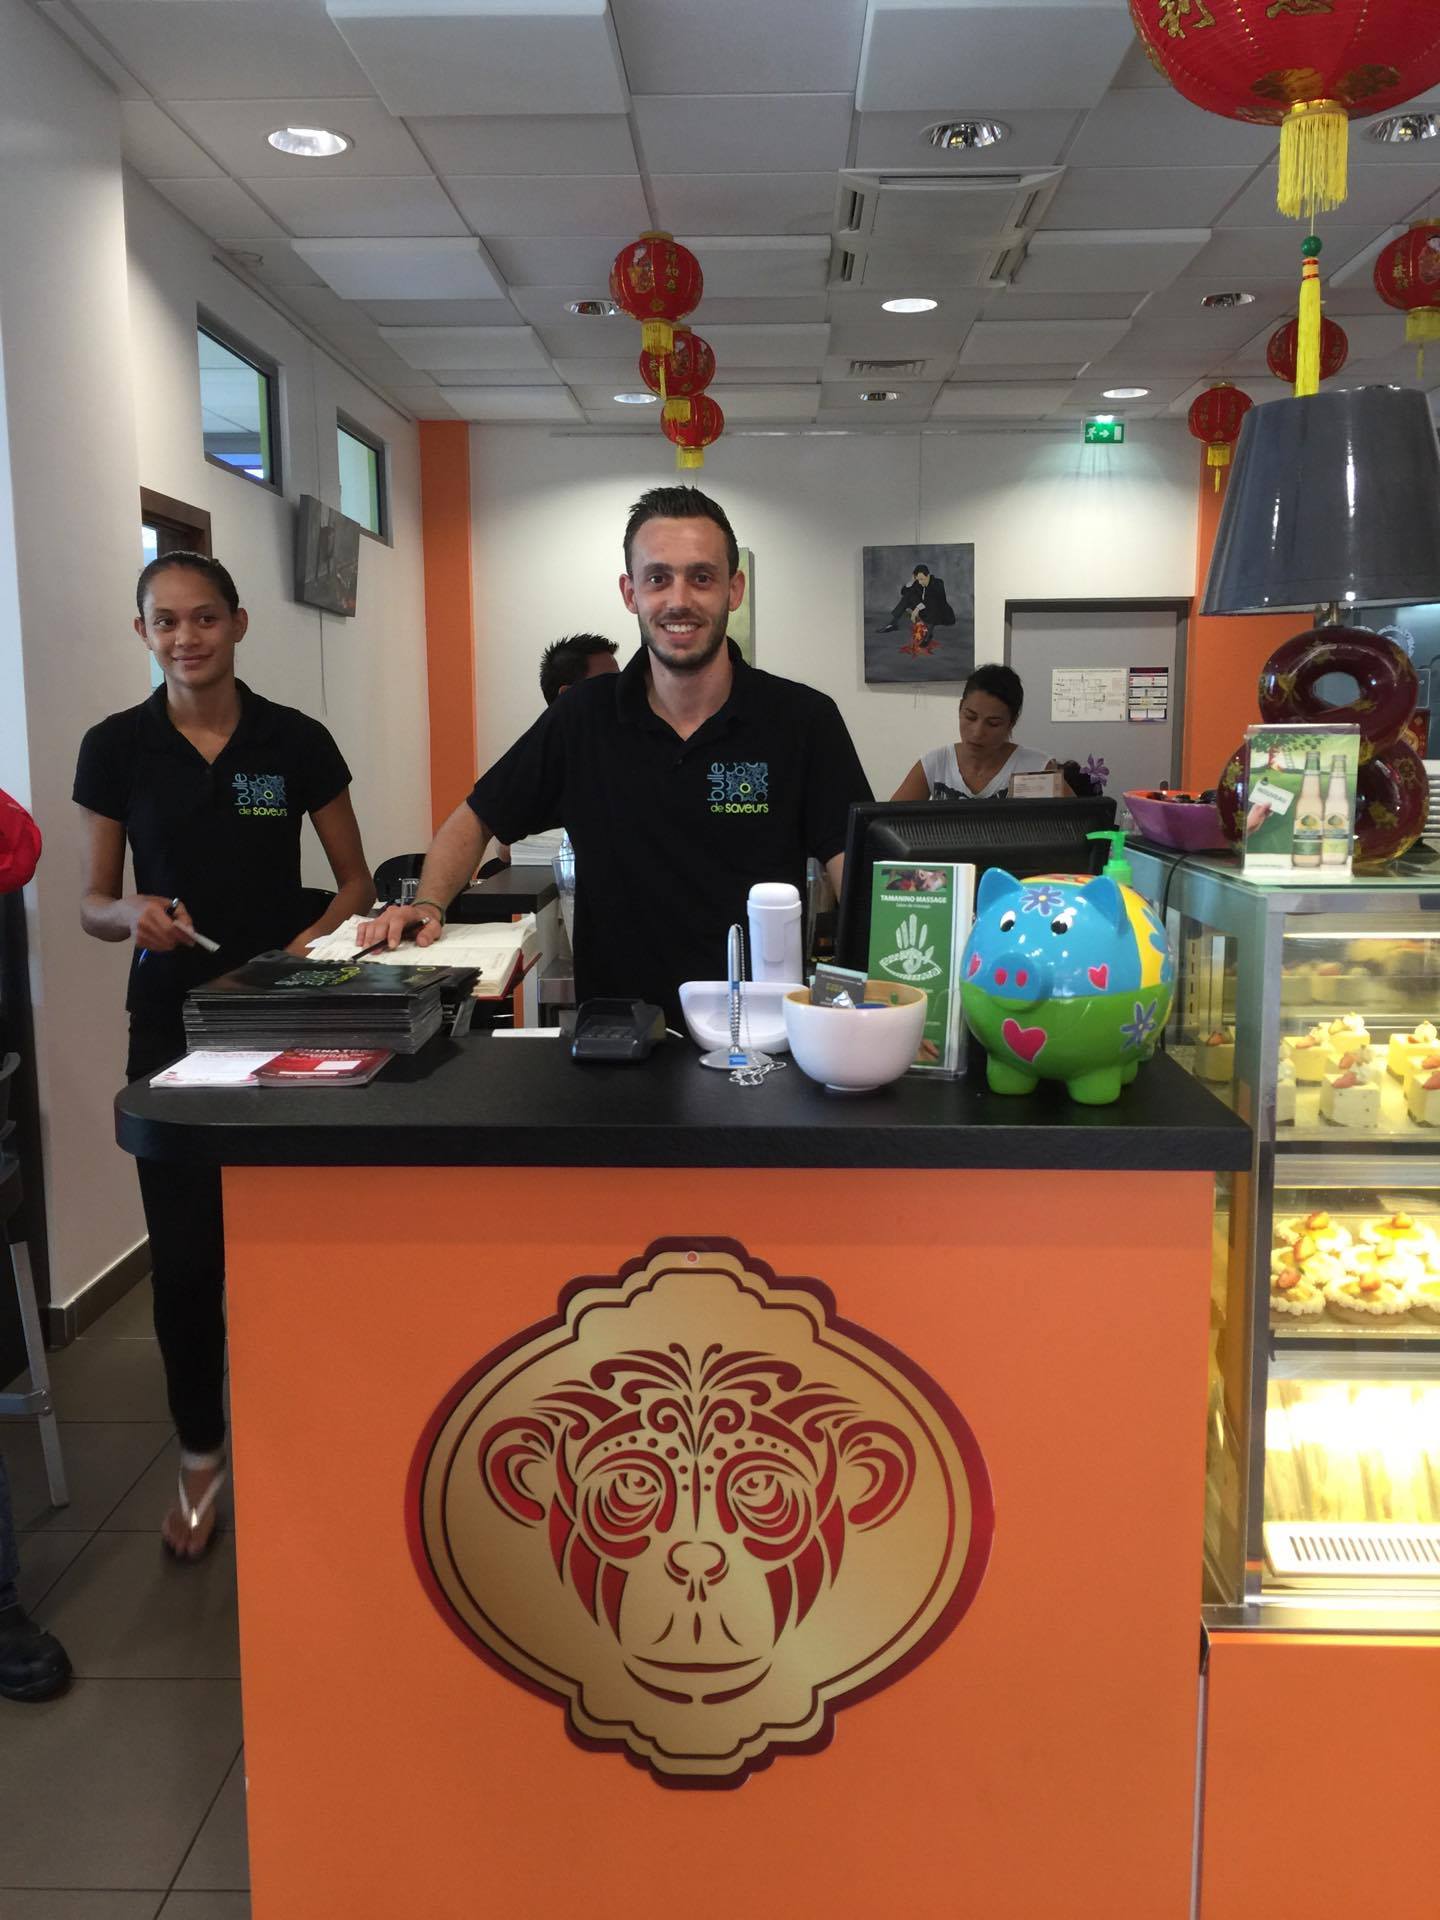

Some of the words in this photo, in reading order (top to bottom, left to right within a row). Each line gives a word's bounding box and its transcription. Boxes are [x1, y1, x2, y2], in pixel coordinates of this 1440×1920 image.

[706, 762, 725, 801] bulle
[231, 773, 251, 806] bulle
[238, 806, 252, 815] de
[252, 806, 288, 817] saveurs
[710, 801, 725, 813] de
[725, 803, 769, 814] saveurs
[880, 894, 915, 903] TAMANINO
[916, 896, 947, 904] MASSAGE
